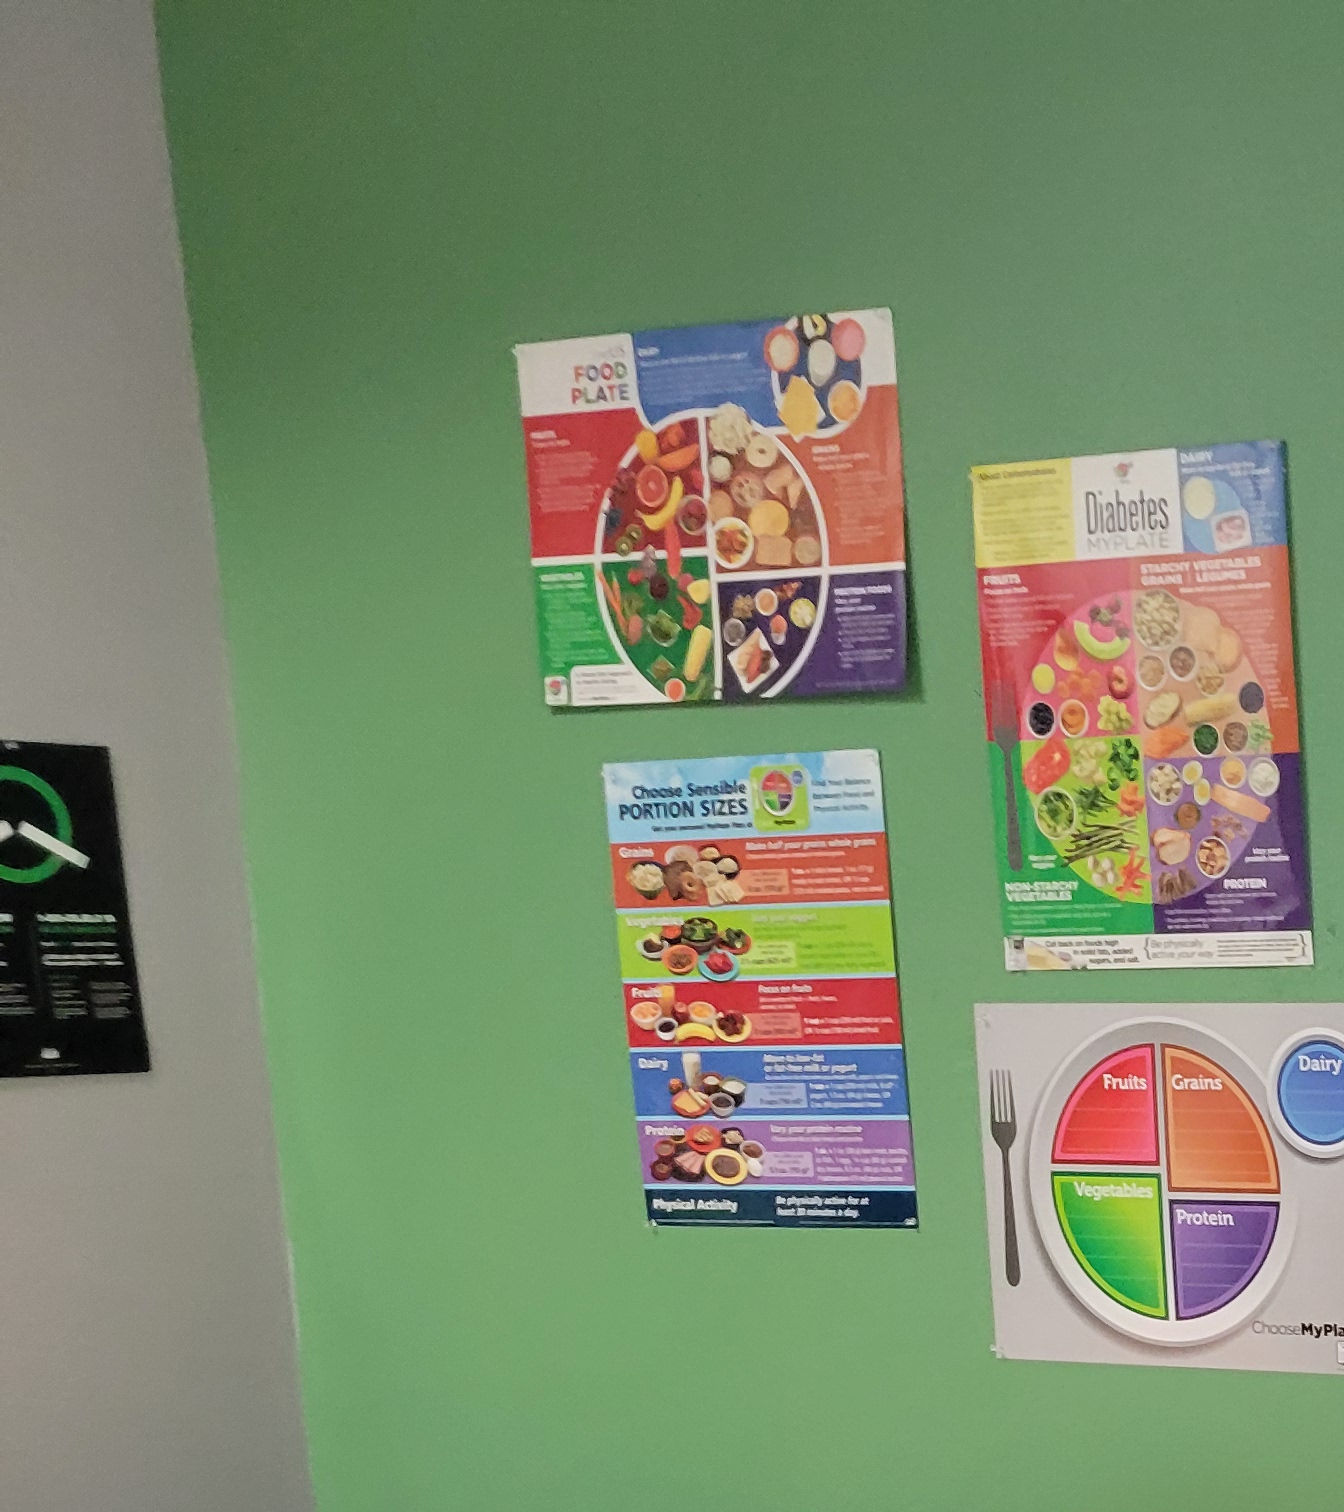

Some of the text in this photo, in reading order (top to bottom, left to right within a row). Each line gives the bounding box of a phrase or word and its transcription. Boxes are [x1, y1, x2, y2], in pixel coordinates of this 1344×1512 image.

[573, 361, 628, 383] FOOD
[571, 383, 631, 404] PLATE
[1084, 489, 1169, 535] Diabetes
[1087, 531, 1170, 553] MYPLATE
[632, 779, 747, 800] Choose Sensible
[618, 798, 748, 821] PORTION SIZES
[1298, 1053, 1343, 1075] Dairy
[1102, 1072, 1148, 1091] Fruits
[1171, 1073, 1223, 1091] Grains
[1073, 1180, 1154, 1201] Vegetables
[652, 1198, 738, 1214] Physical Activity
[1175, 1207, 1235, 1227] Protein
